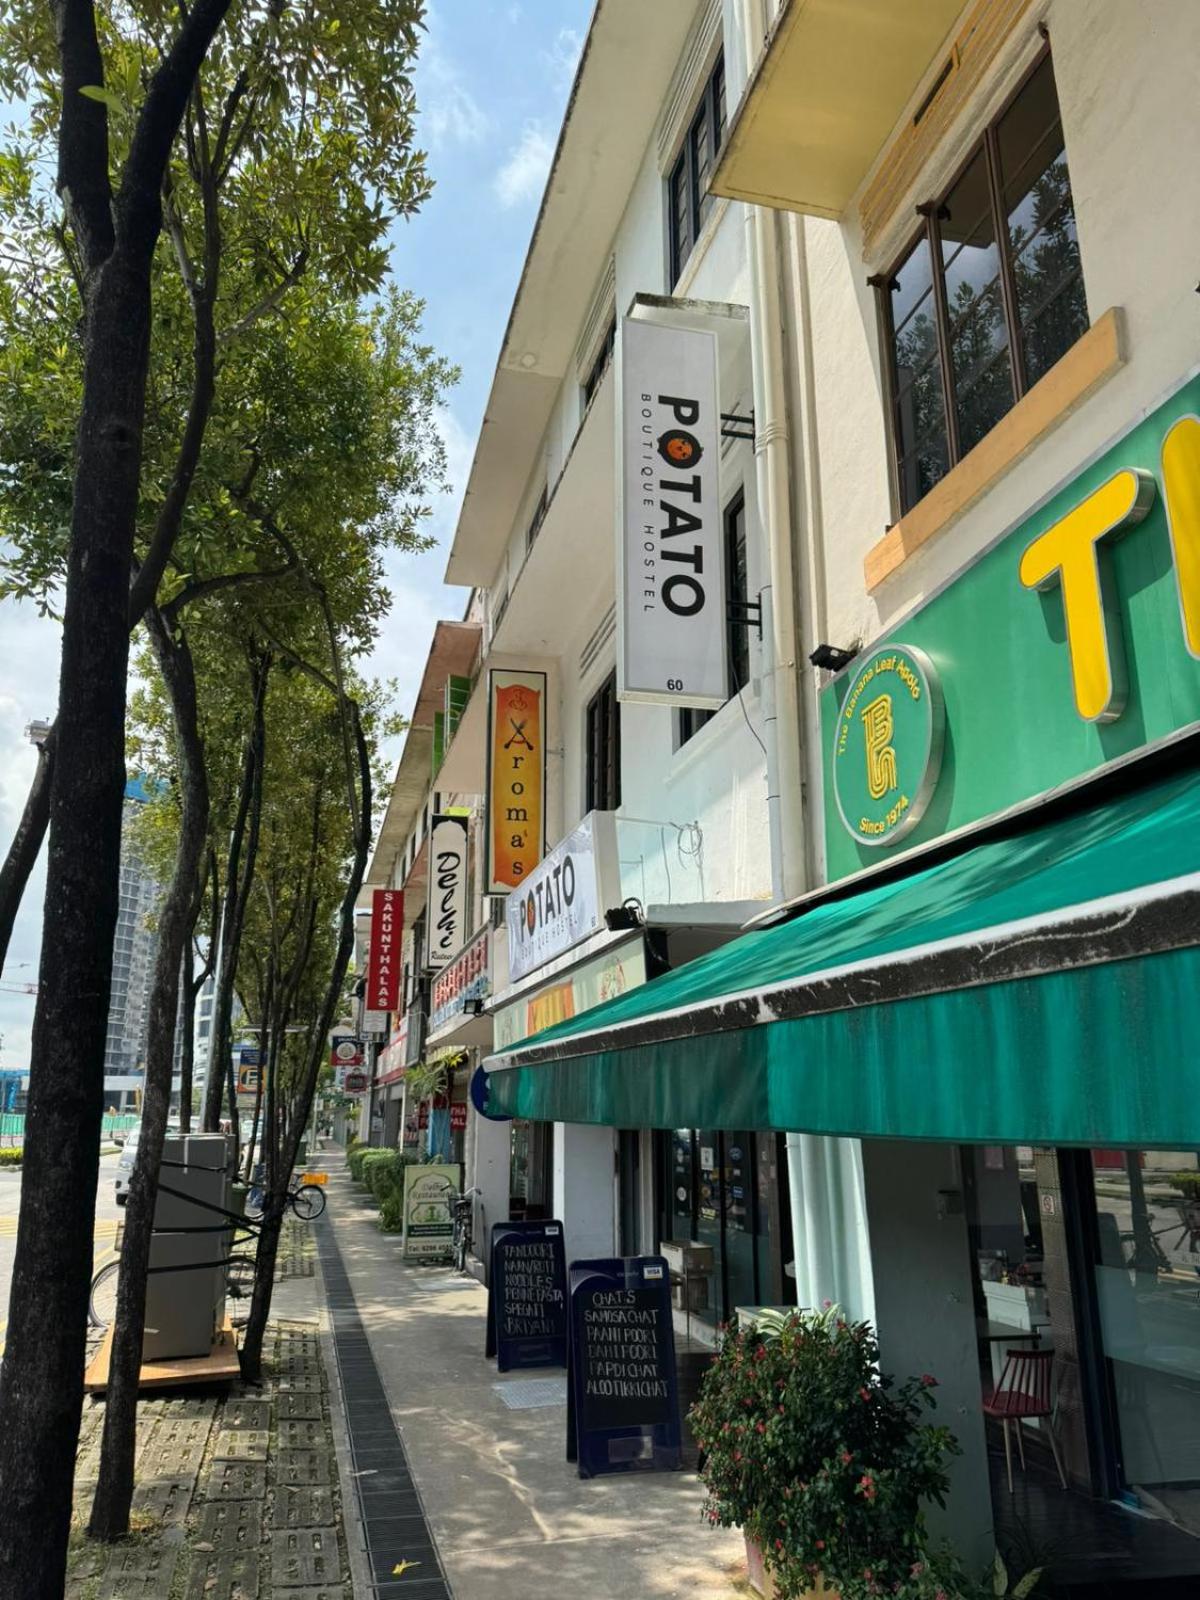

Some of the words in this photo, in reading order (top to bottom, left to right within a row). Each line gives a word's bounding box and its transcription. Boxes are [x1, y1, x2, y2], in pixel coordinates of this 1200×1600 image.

[640, 393, 654, 507] BOUTIQUE
[657, 394, 706, 617] POTATO
[643, 525, 655, 613] HOSTEL
[666, 678, 684, 692] 60
[859, 816, 885, 834] Since
[519, 854, 576, 944] POTATO
[377, 892, 394, 1007] SAKUNTHALAS
[627, 1308, 659, 1324] CHAT
[627, 1362, 659, 1377] CHAT
[640, 1380, 668, 1398] CHAT
